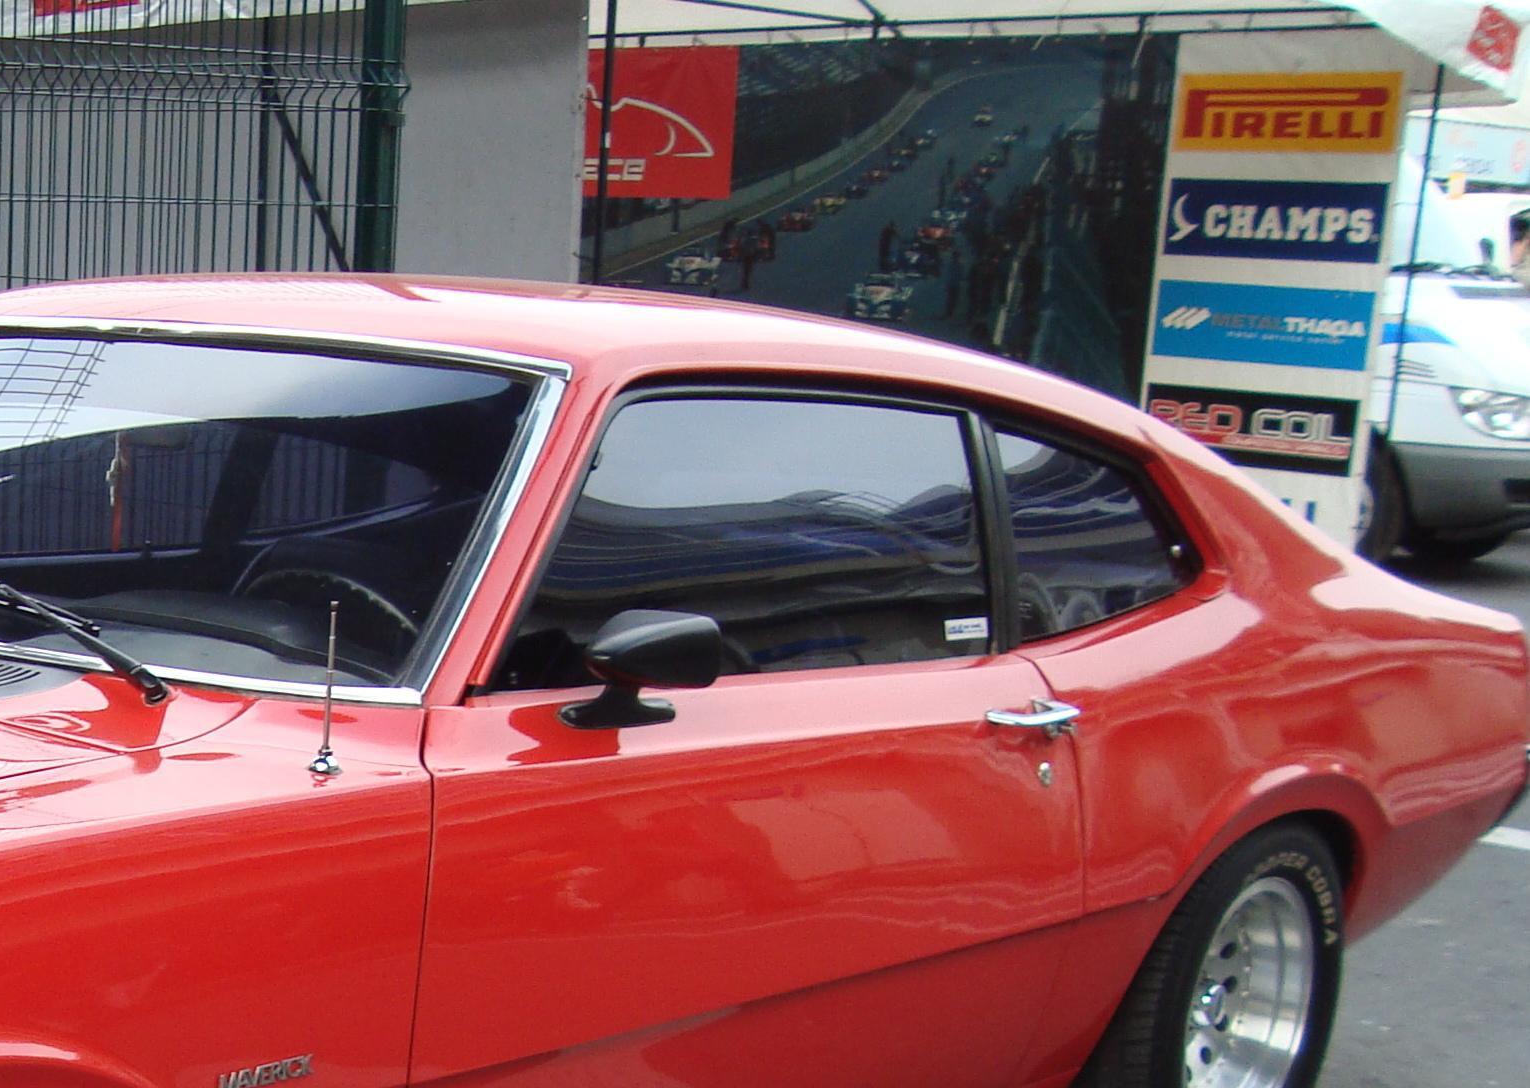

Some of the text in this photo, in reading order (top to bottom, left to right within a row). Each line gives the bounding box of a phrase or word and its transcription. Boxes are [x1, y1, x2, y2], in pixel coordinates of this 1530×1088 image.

[1183, 87, 1389, 139] PIRELLI
[1203, 203, 1376, 244] CHAMPS
[1150, 399, 1352, 444] RED COIL
